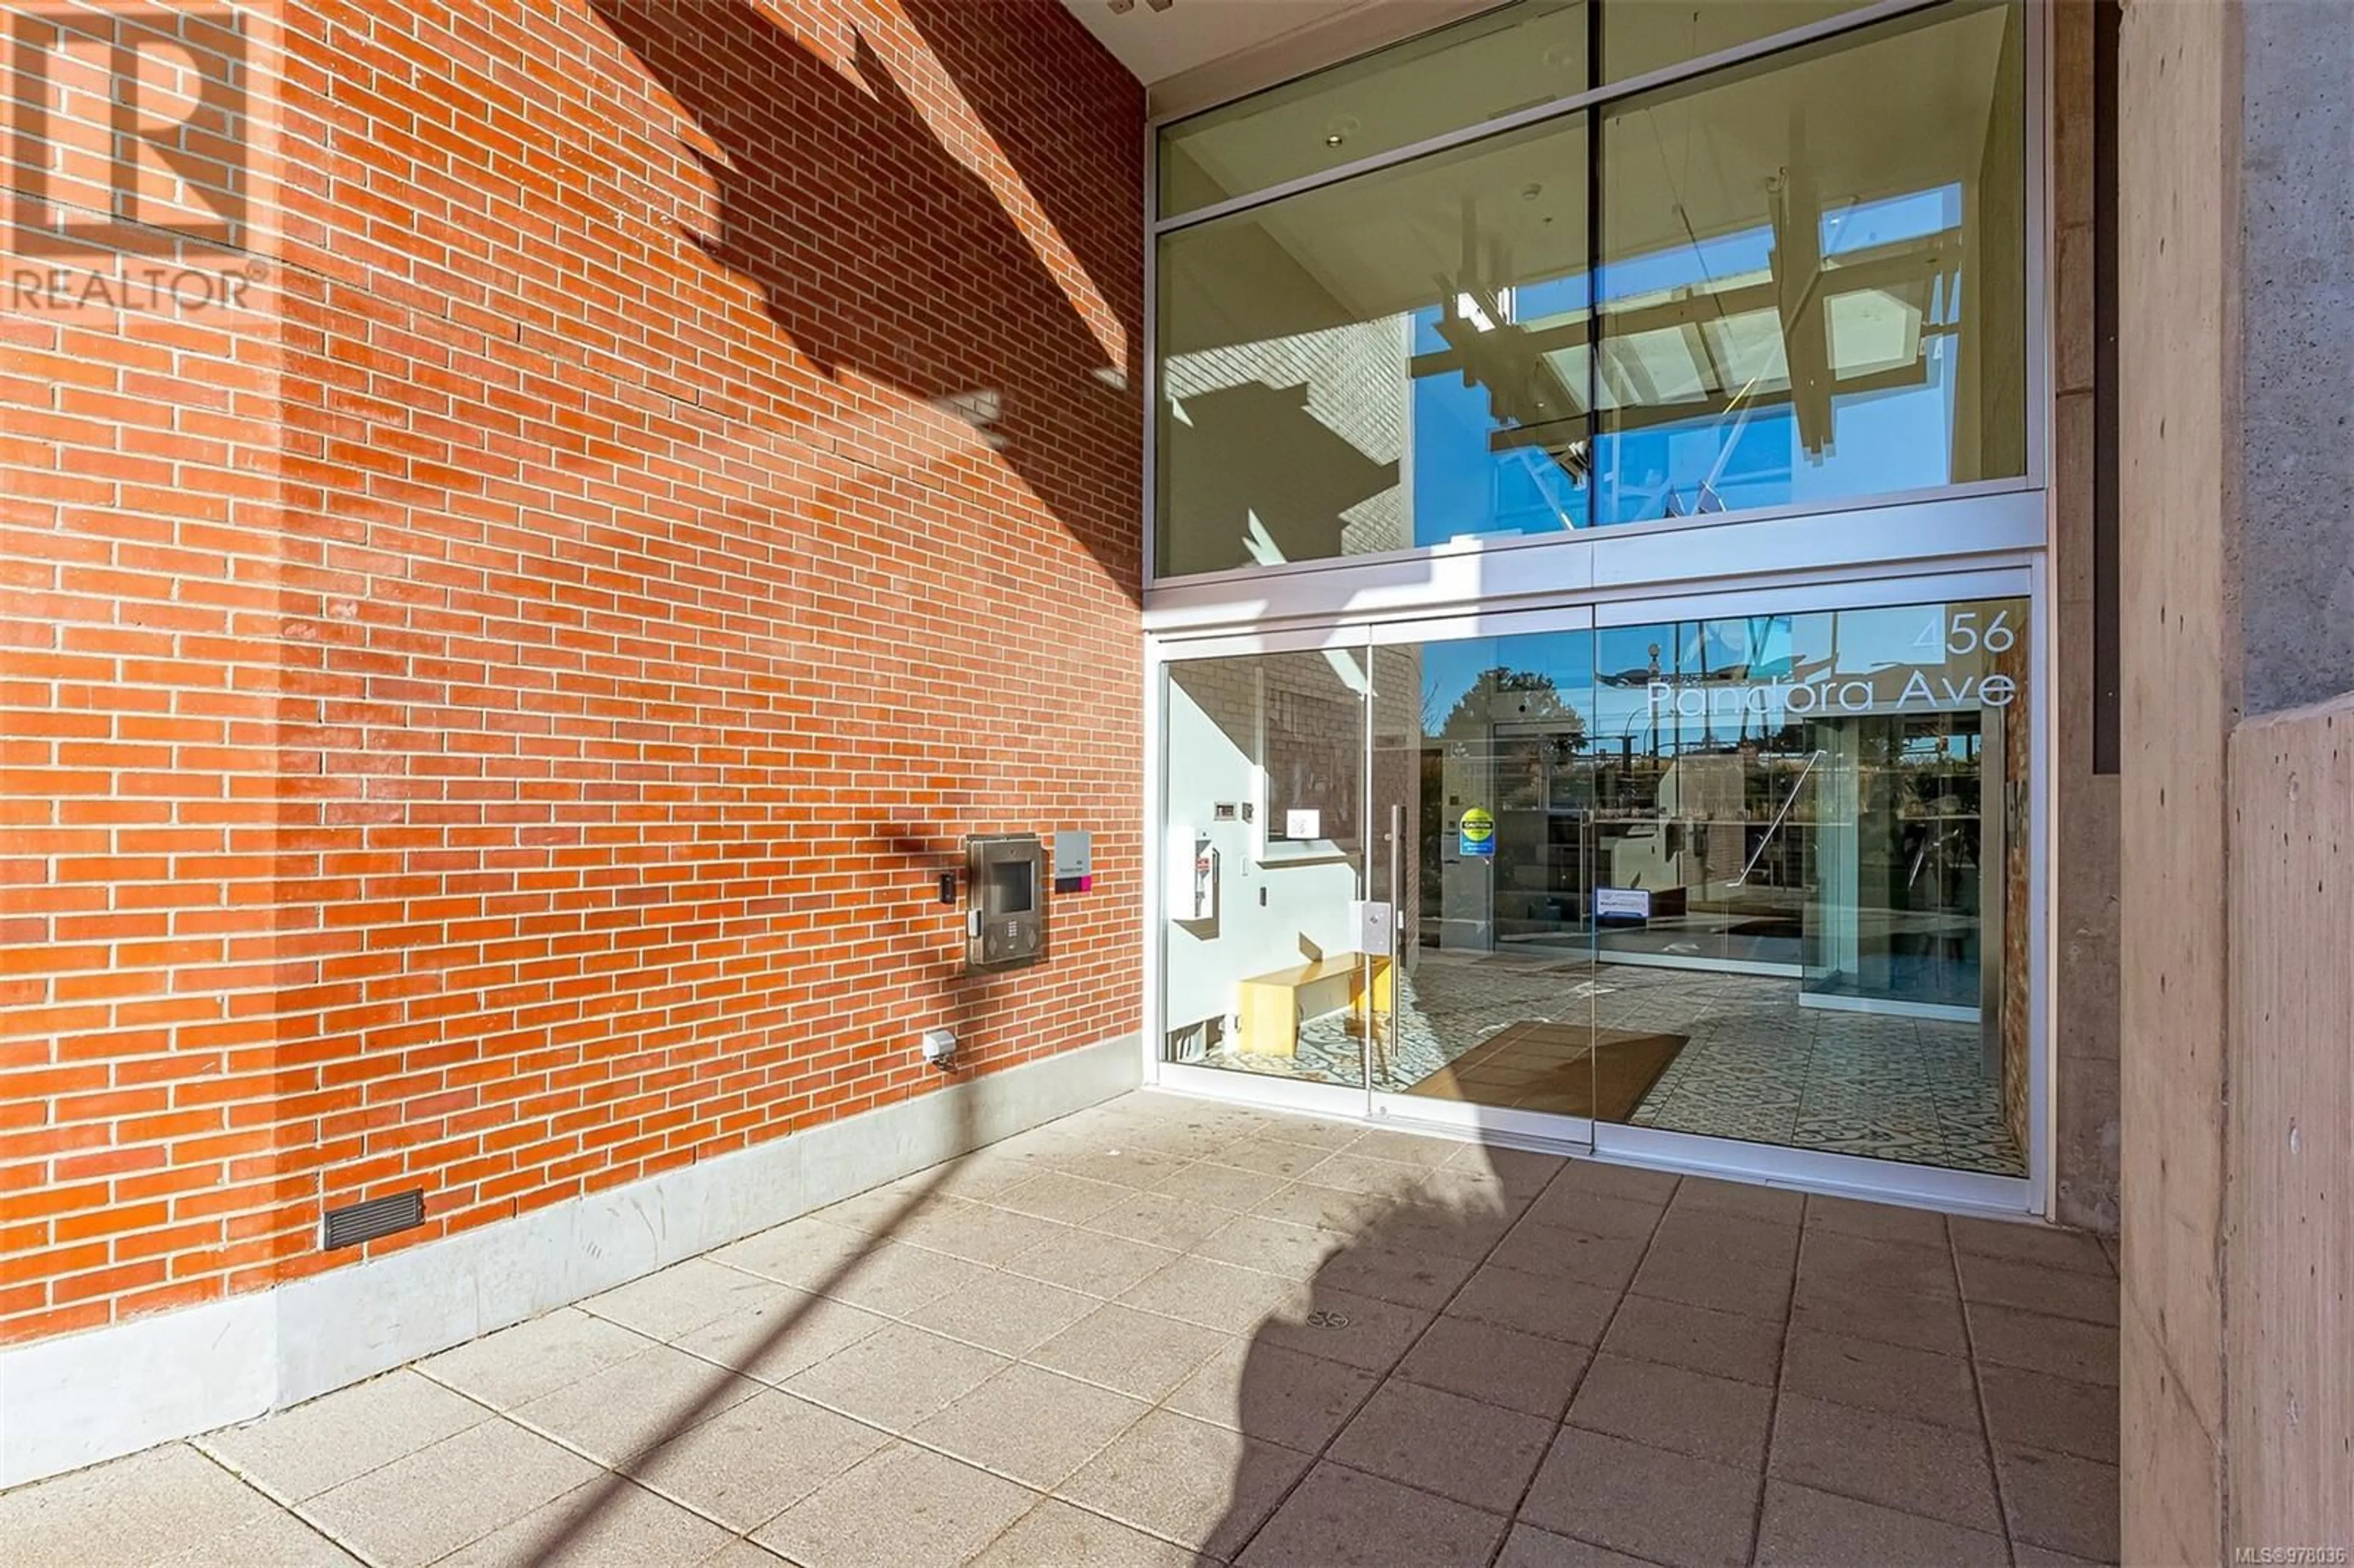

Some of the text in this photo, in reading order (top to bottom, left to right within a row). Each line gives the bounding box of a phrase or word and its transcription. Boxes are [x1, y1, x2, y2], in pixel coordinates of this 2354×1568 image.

[1913, 610, 2014, 654] 456
[1647, 669, 2015, 717] Pandora Ave
